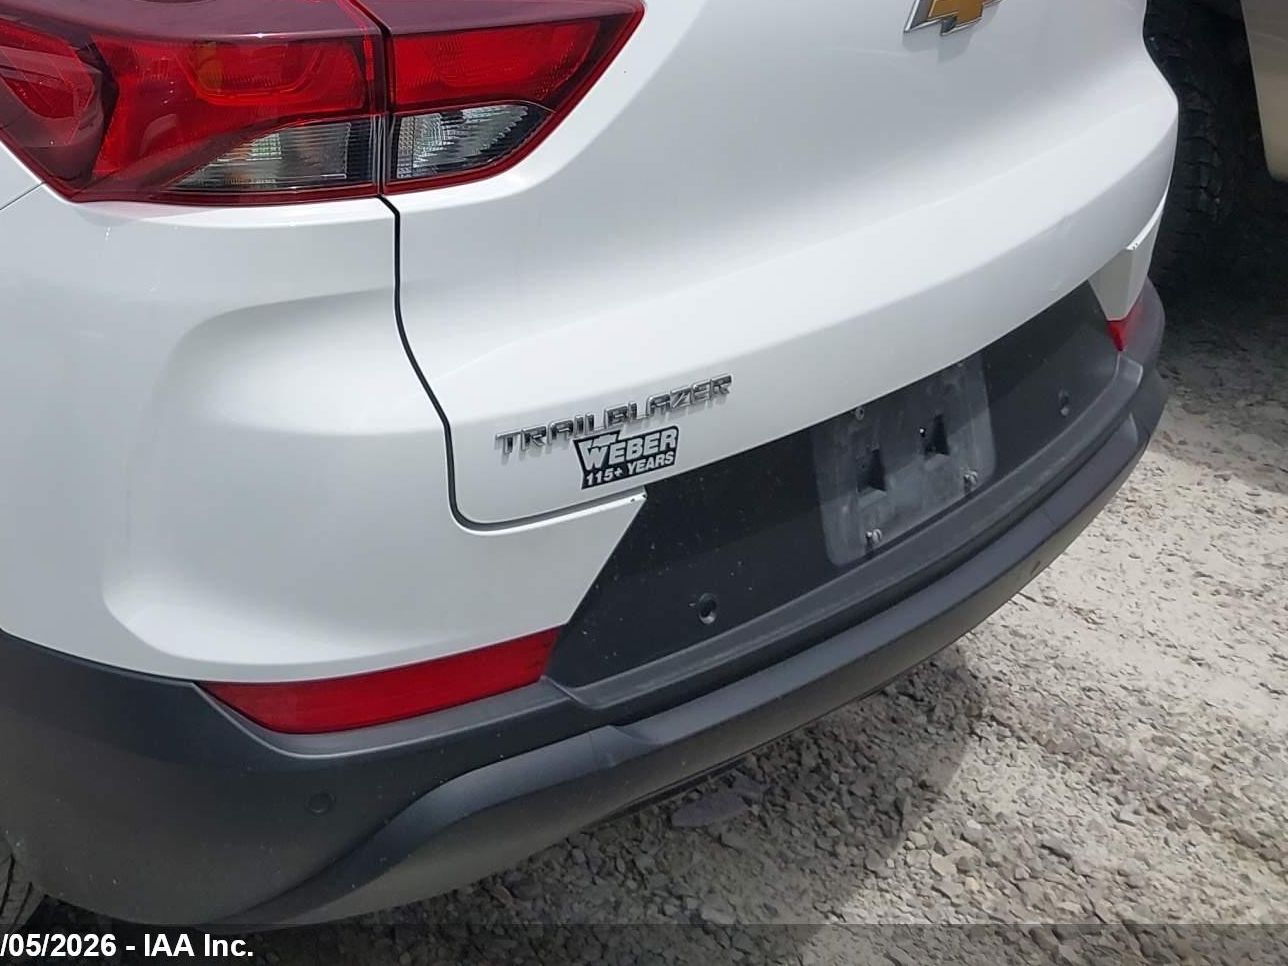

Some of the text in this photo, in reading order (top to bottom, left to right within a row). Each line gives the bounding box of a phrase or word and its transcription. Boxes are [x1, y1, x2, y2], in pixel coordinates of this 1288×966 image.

[496, 374, 732, 454] TRAILBLAZER
[578, 428, 678, 471] WEBER
[585, 451, 675, 486] 115+ YEARS
